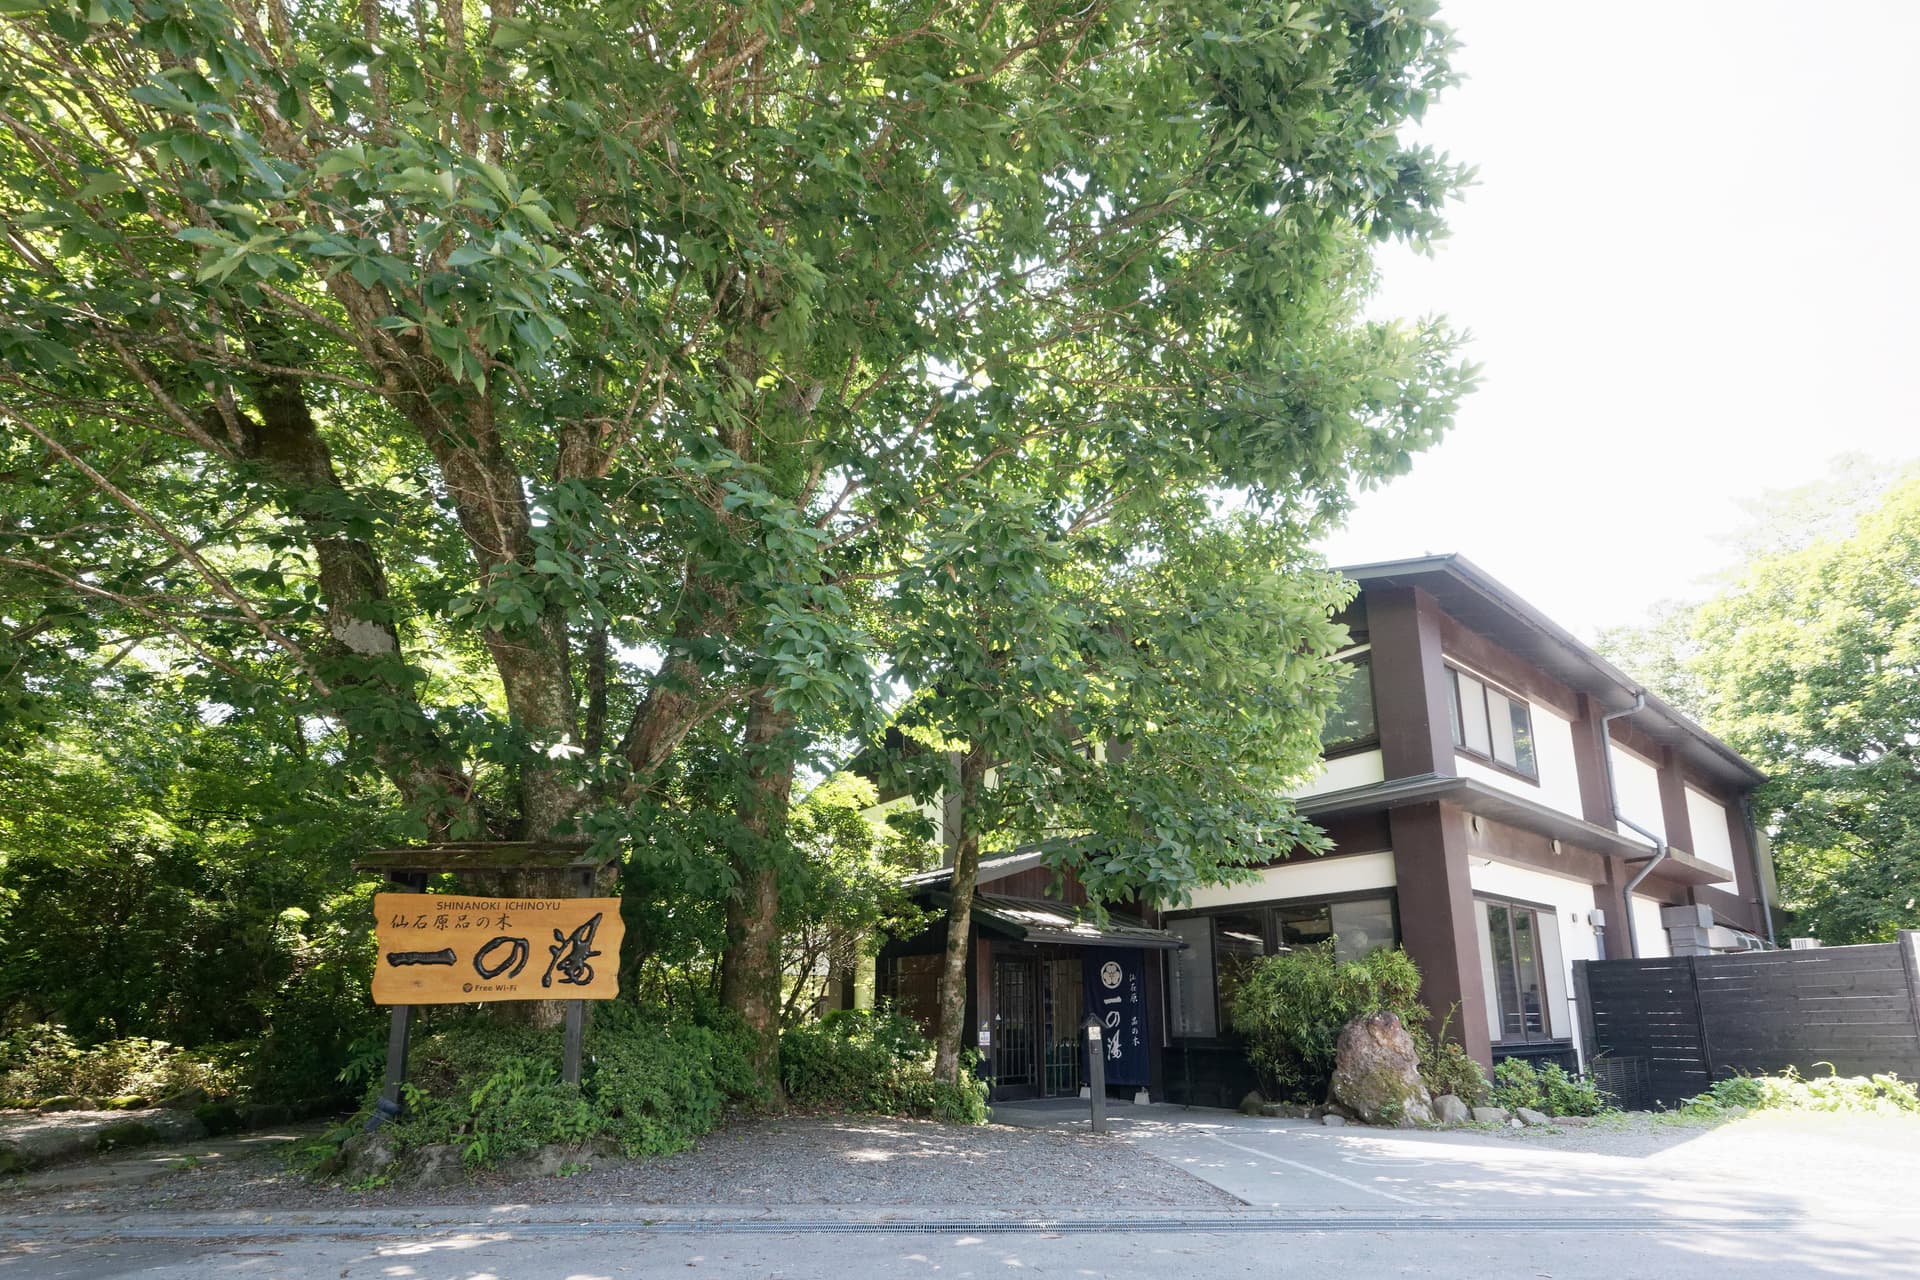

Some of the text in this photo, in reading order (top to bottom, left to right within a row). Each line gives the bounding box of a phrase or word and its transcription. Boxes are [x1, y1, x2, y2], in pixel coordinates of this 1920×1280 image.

[436, 901, 561, 911] SHINANOKI ICHINOYU
[391, 913, 513, 931] 仙石原品の木
[387, 912, 602, 988] 一の湯
[475, 984, 517, 992] Free Wi-Fi
[1104, 996, 1122, 1061] 一の湯
